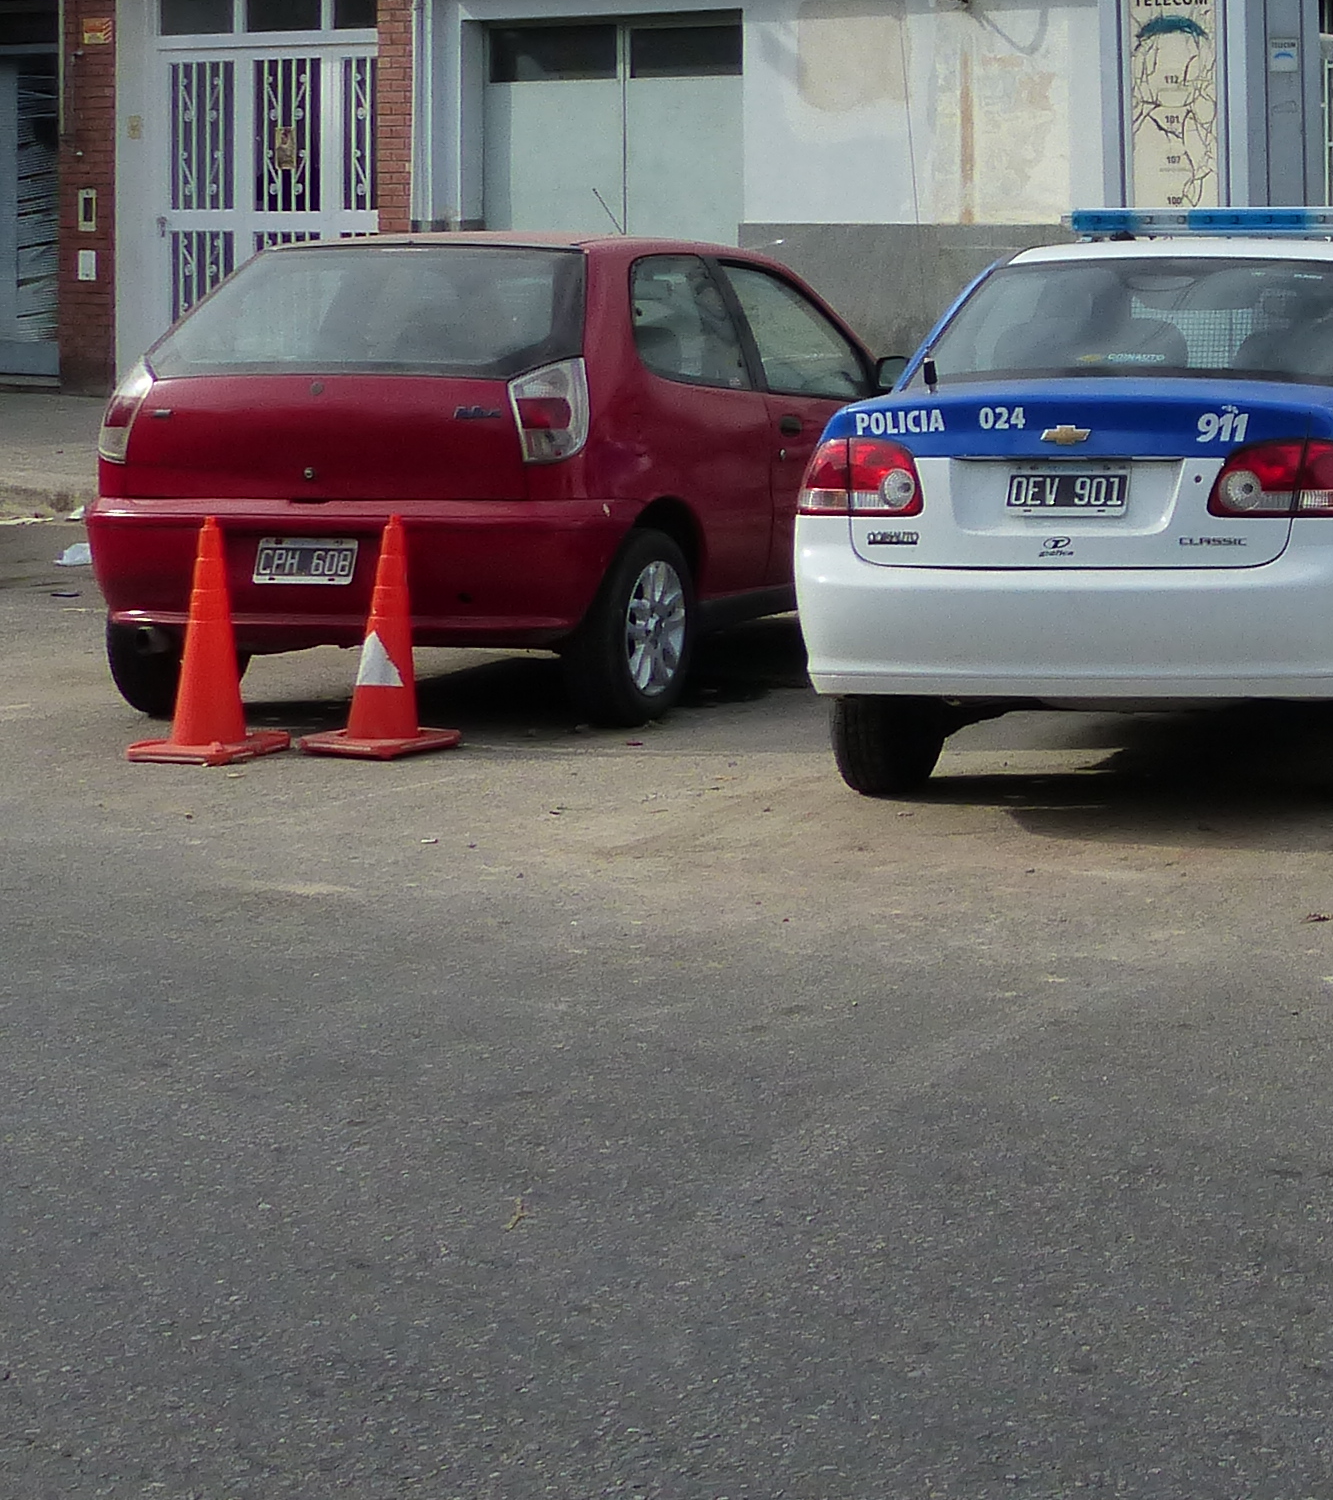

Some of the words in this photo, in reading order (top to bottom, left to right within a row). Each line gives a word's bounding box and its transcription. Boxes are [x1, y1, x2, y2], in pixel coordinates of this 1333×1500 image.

[1164, 115, 1180, 124] 101
[856, 409, 945, 436] POLICIA
[978, 407, 1026, 430] 024
[1196, 412, 1249, 442] 911
[1011, 476, 1060, 505] OEV
[1074, 476, 1122, 505] 901
[1179, 537, 1248, 546] CLASSIC
[259, 550, 300, 574] CPH
[311, 551, 351, 575] 608
